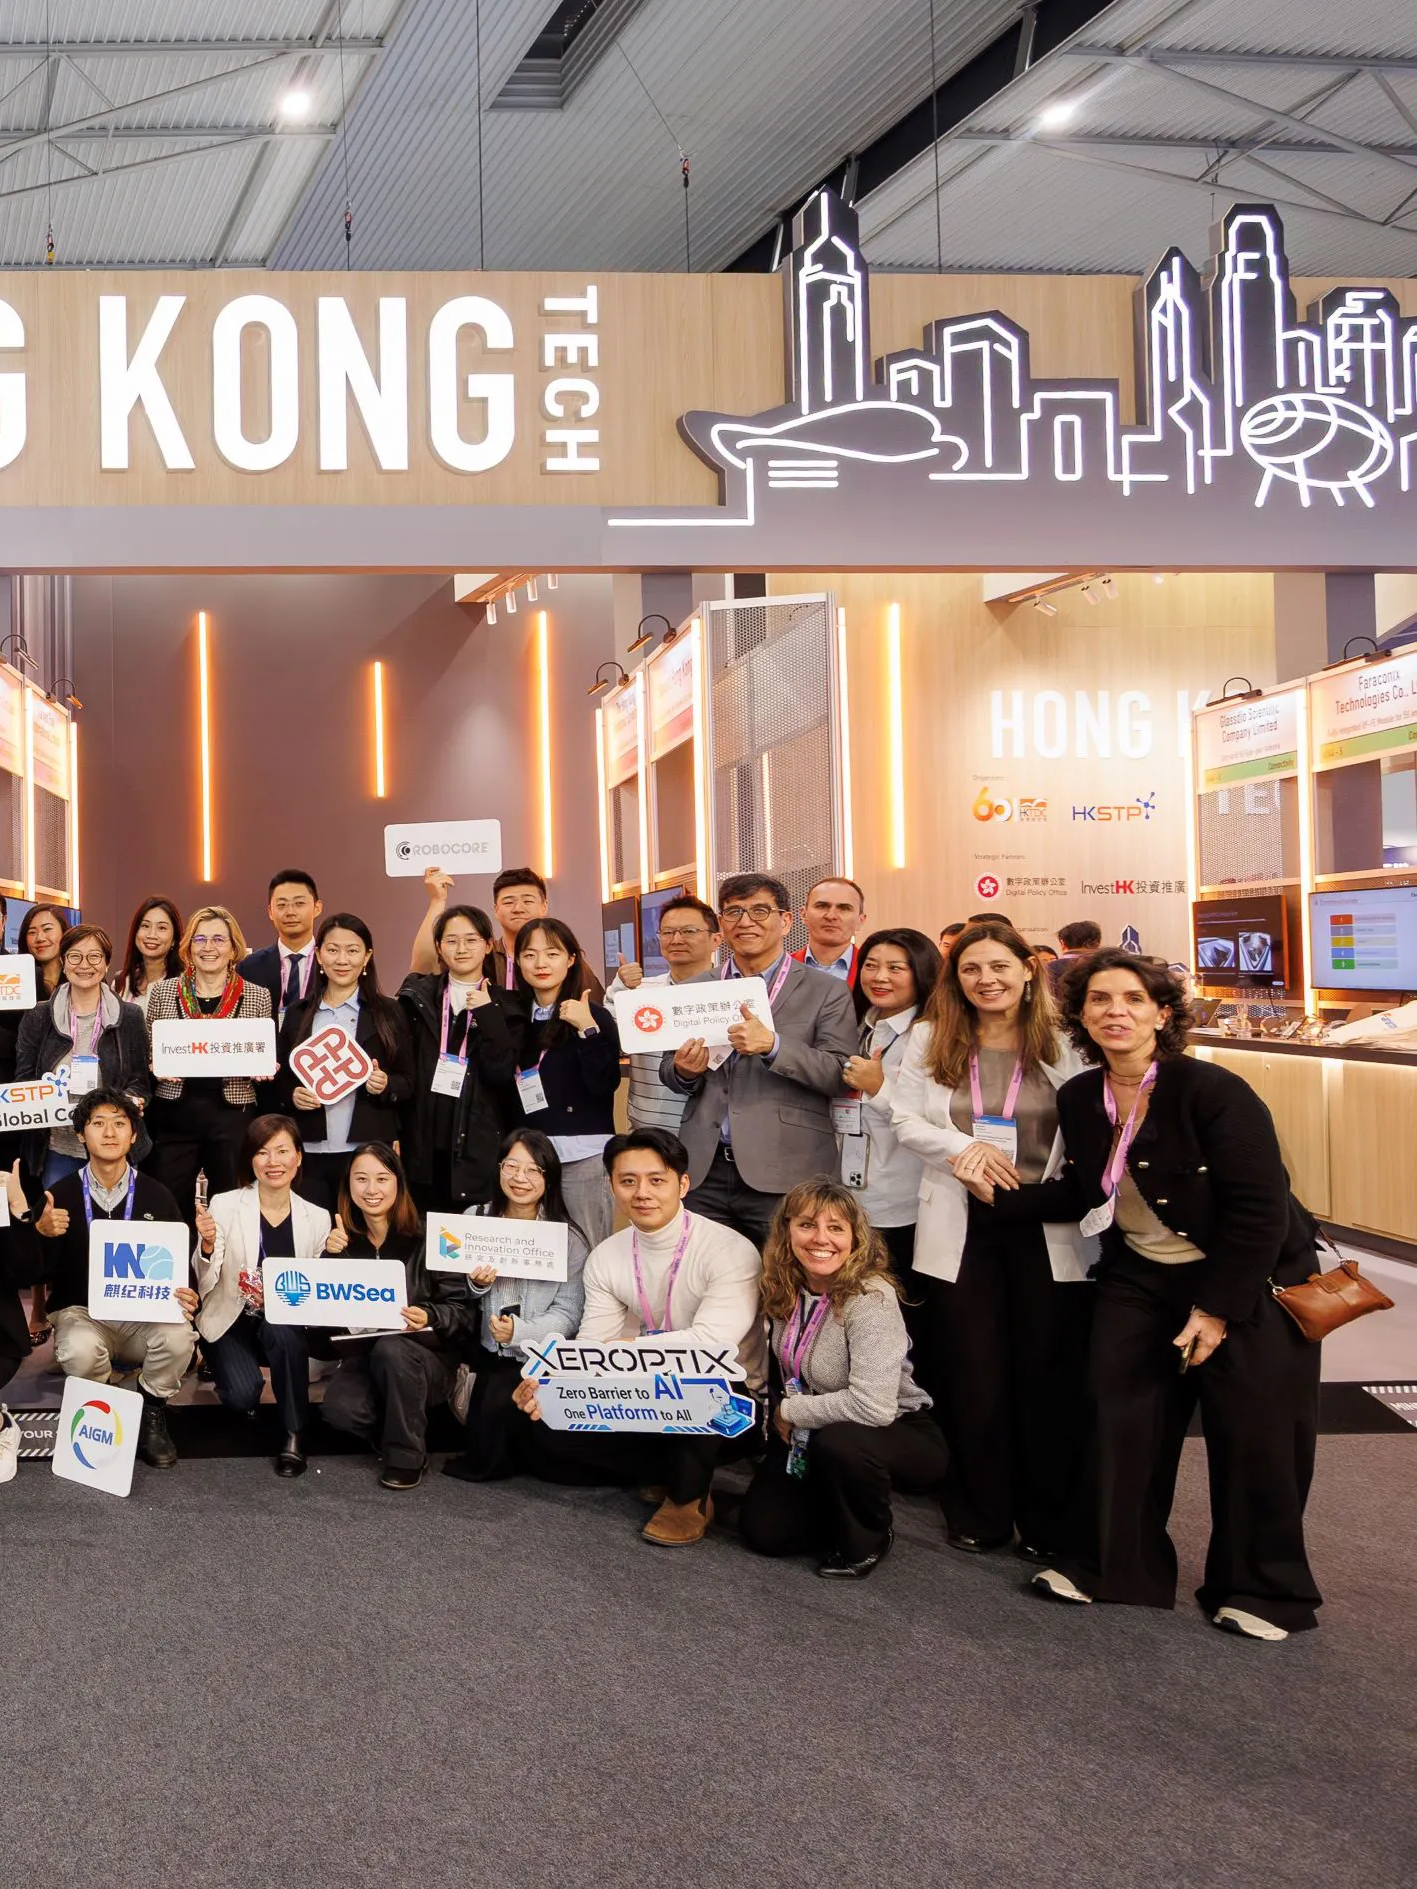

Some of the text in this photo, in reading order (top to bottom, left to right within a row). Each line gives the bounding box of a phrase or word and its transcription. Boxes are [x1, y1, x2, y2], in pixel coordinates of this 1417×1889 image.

[99, 293, 515, 474] KONG
[543, 285, 600, 471] TECH
[990, 690, 1153, 760] HONG
[1072, 805, 1142, 821] HKSTP
[412, 841, 489, 856] ROBOCORE
[1080, 880, 1187, 895] InvestHK 投資推廣
[673, 1018, 702, 1029] Digital
[703, 1016, 730, 1026] Policy
[161, 1041, 266, 1055] InvestHK 投資推廣署
[464, 1232, 535, 1246] Research and
[464, 1243, 555, 1258] Innovation Office
[103, 1283, 172, 1301] 麒纪科技
[316, 1282, 396, 1303] BWSea
[527, 1339, 738, 1377] XEROPTIX
[556, 1374, 684, 1400] Zero Barrier to AI
[564, 1404, 693, 1422] One Platform to All
[78, 1424, 114, 1446] AIGM
